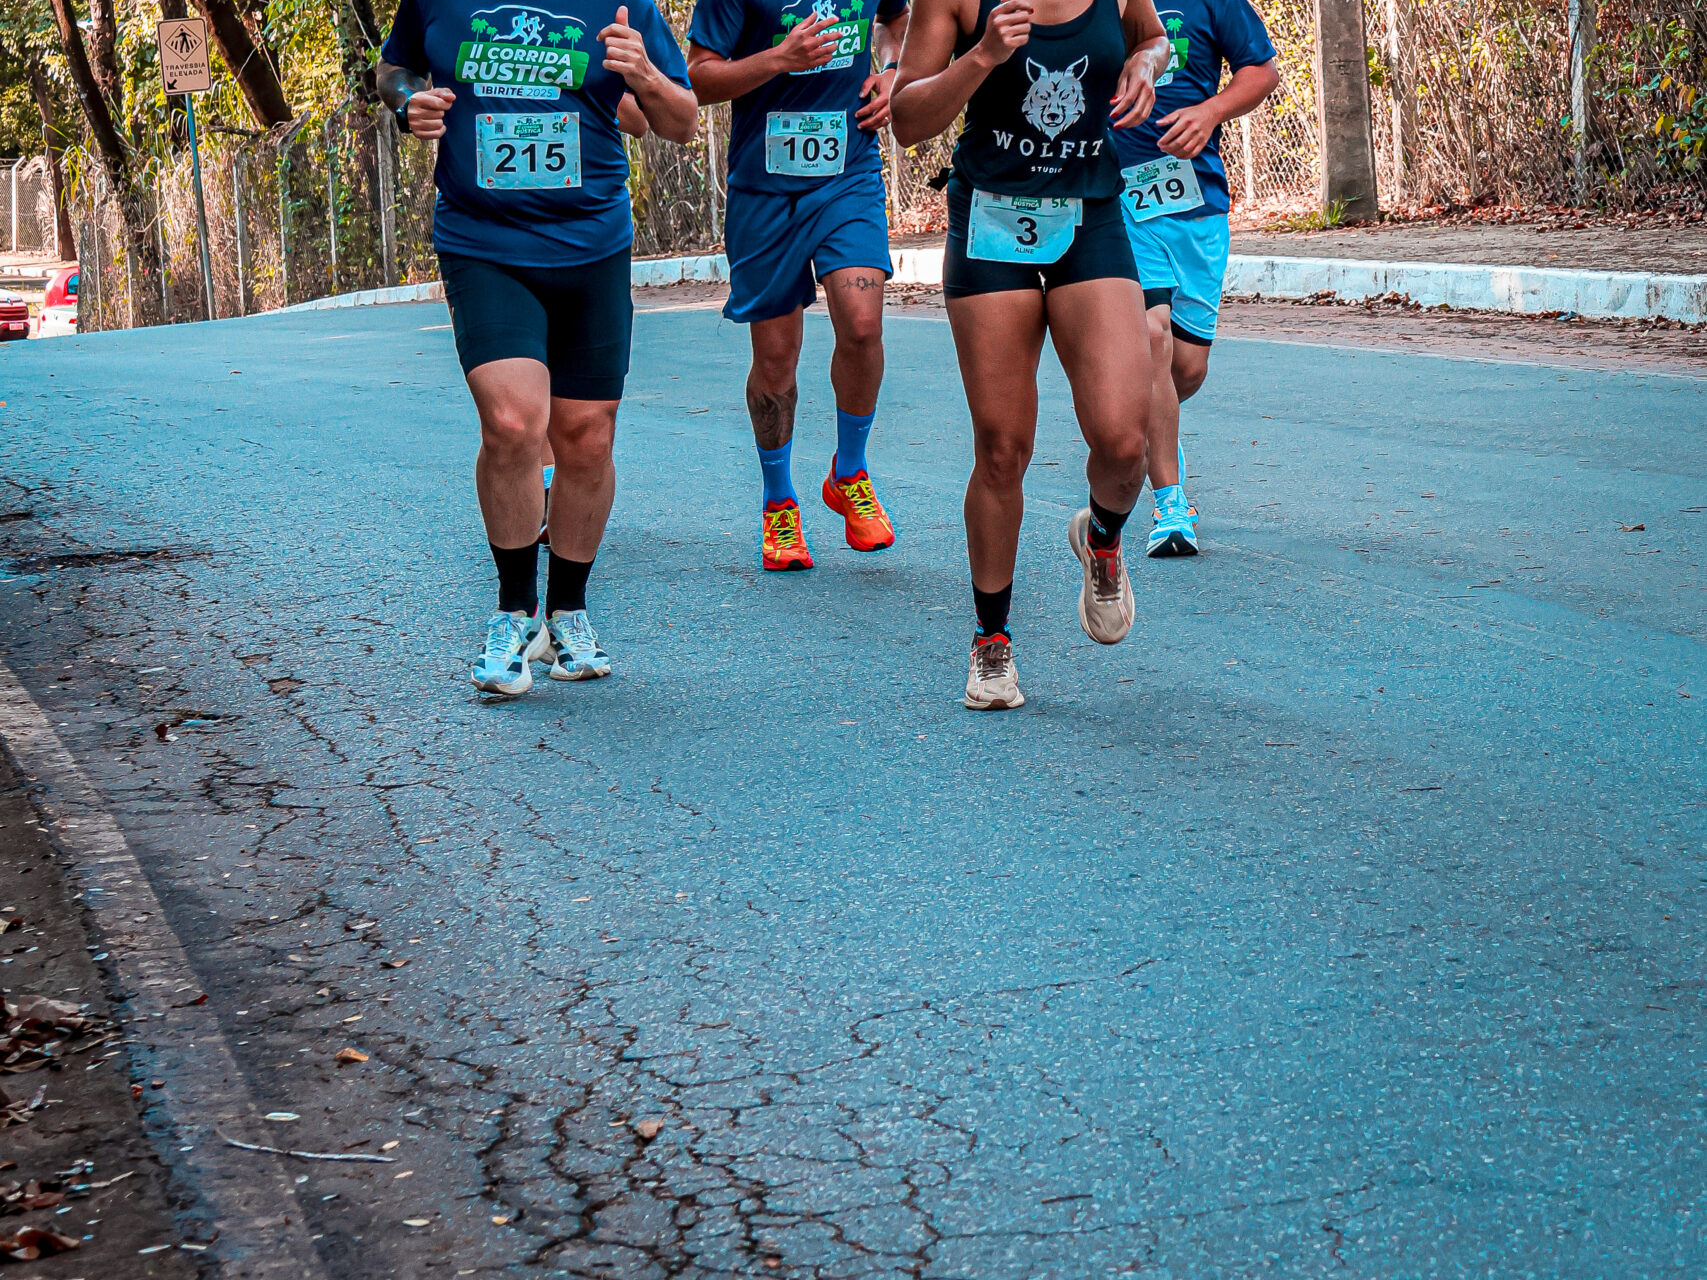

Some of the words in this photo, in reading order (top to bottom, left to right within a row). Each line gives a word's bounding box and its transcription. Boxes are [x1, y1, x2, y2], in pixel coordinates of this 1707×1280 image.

[470, 44, 483, 58] II
[487, 47, 571, 66] CORRIDA
[170, 69, 203, 77] ELEVADA
[462, 60, 573, 86] RÚSTICA
[527, 88, 553, 97] 2025
[784, 137, 839, 161] 103
[993, 130, 1103, 159] WOLFIT
[495, 143, 566, 172] 215
[1031, 166, 1062, 174] STUDIO
[1128, 178, 1185, 210] 219
[1016, 217, 1038, 246] 3
